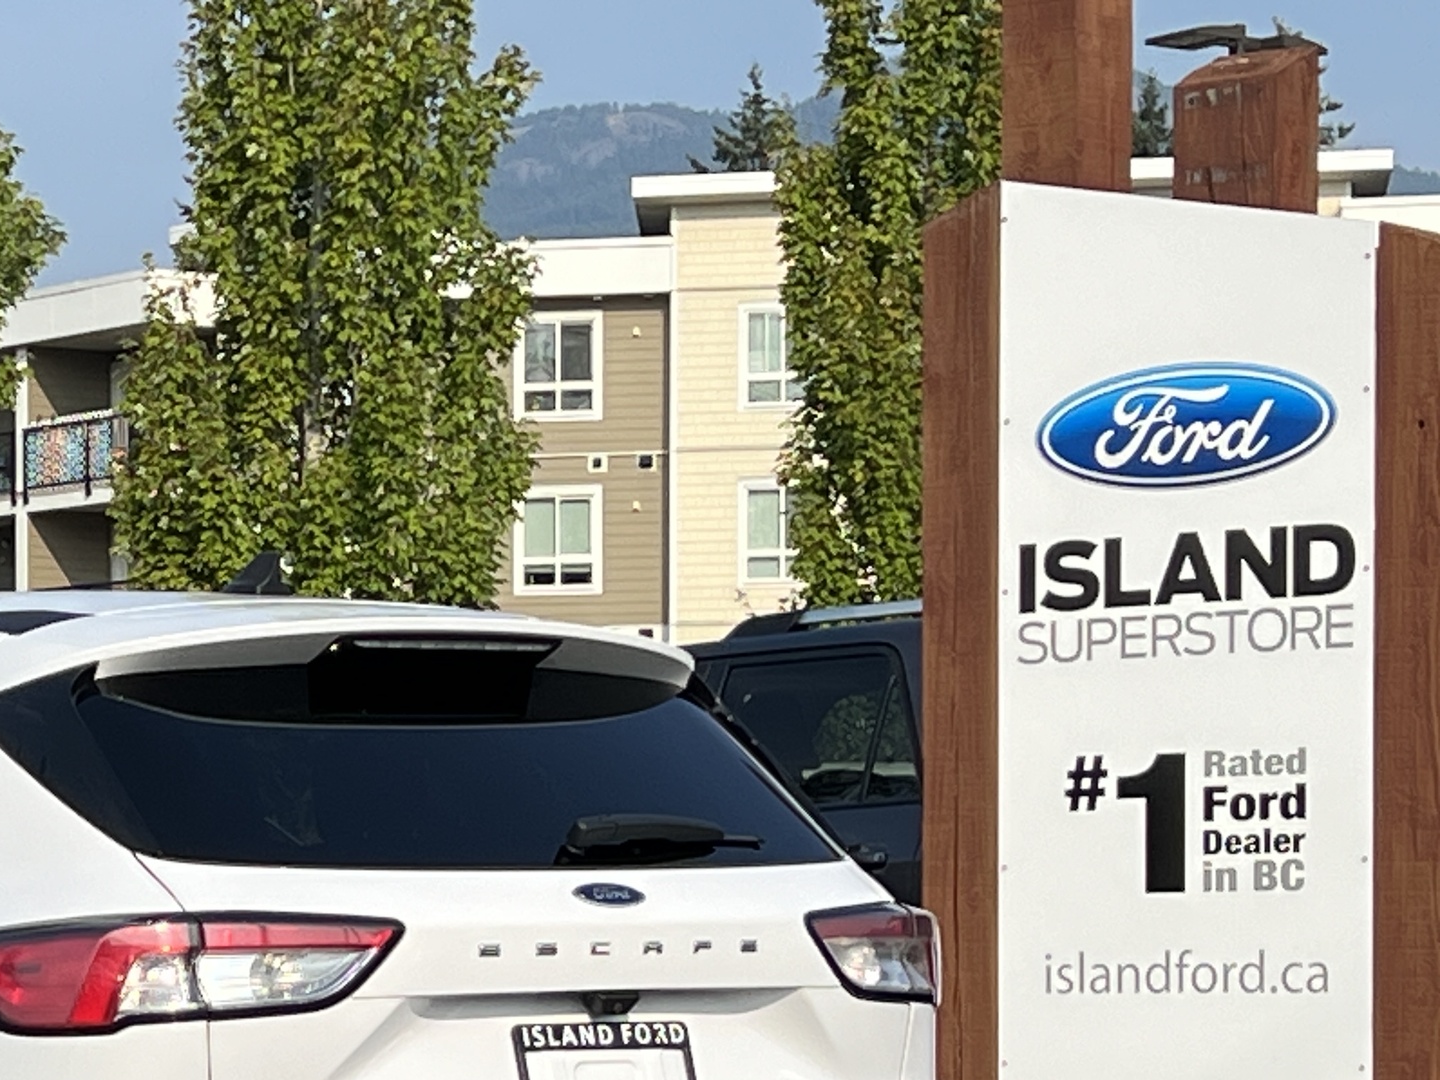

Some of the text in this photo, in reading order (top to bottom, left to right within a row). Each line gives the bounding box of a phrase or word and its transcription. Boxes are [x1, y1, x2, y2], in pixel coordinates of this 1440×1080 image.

[1095, 384, 1275, 469] Ford
[1018, 523, 1356, 614] ISLAND
[1017, 603, 1355, 665] SUPERSTORE
[1203, 747, 1307, 777] Rated
[1064, 753, 1186, 893] #1
[1203, 783, 1307, 822] Ford
[1203, 828, 1307, 855] Dealer
[1203, 858, 1305, 892] in BC
[1045, 949, 1329, 994] islandford.ca
[522, 1023, 685, 1047] ISLAND FORD
